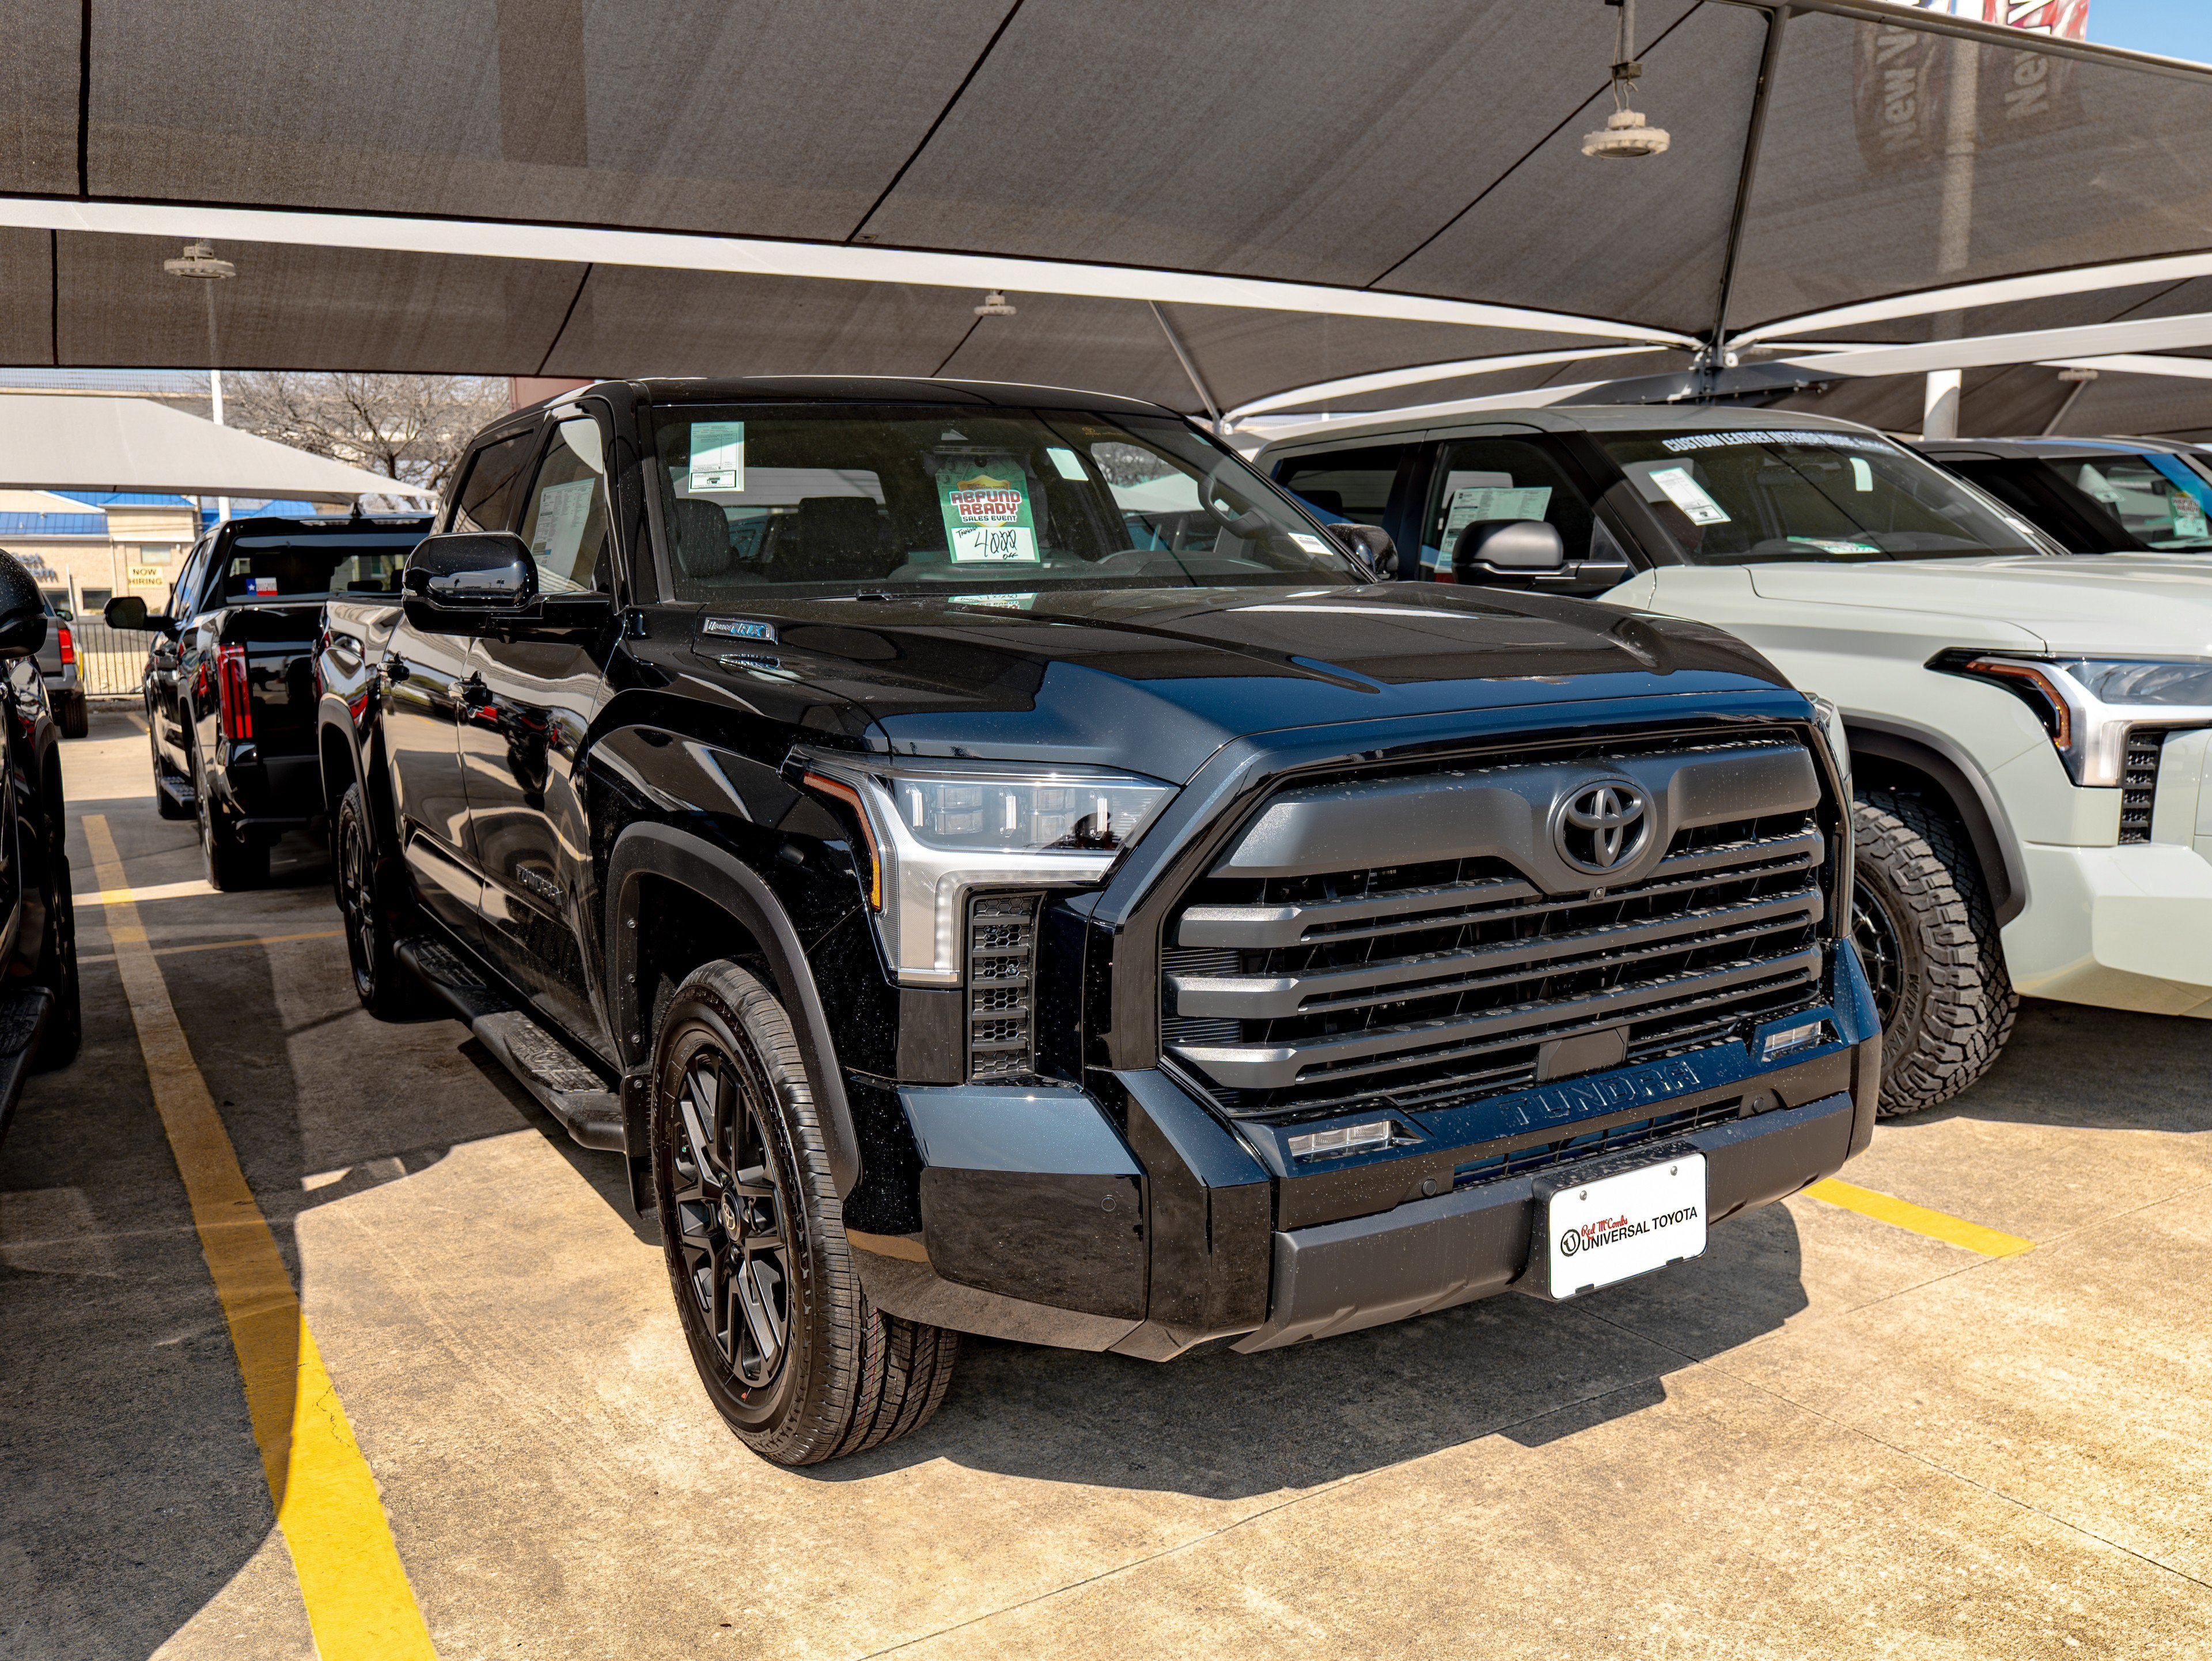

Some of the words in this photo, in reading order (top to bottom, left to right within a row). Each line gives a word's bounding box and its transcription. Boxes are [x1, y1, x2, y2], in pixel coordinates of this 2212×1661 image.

[1662, 434, 1725, 452] CUSTOM
[1715, 431, 1770, 445] LEATHER
[950, 490, 1021, 504] REFUND
[960, 503, 1017, 516] READY
[128, 577, 162, 586] HIRING
[1497, 1061, 1699, 1125] TUNDRA
[1581, 1224, 1596, 1240] Red
[1597, 1214, 1628, 1233] McCombs
[1582, 1223, 1650, 1251] UNIVERSAL
[1652, 1206, 1698, 1230] TOYOTA
